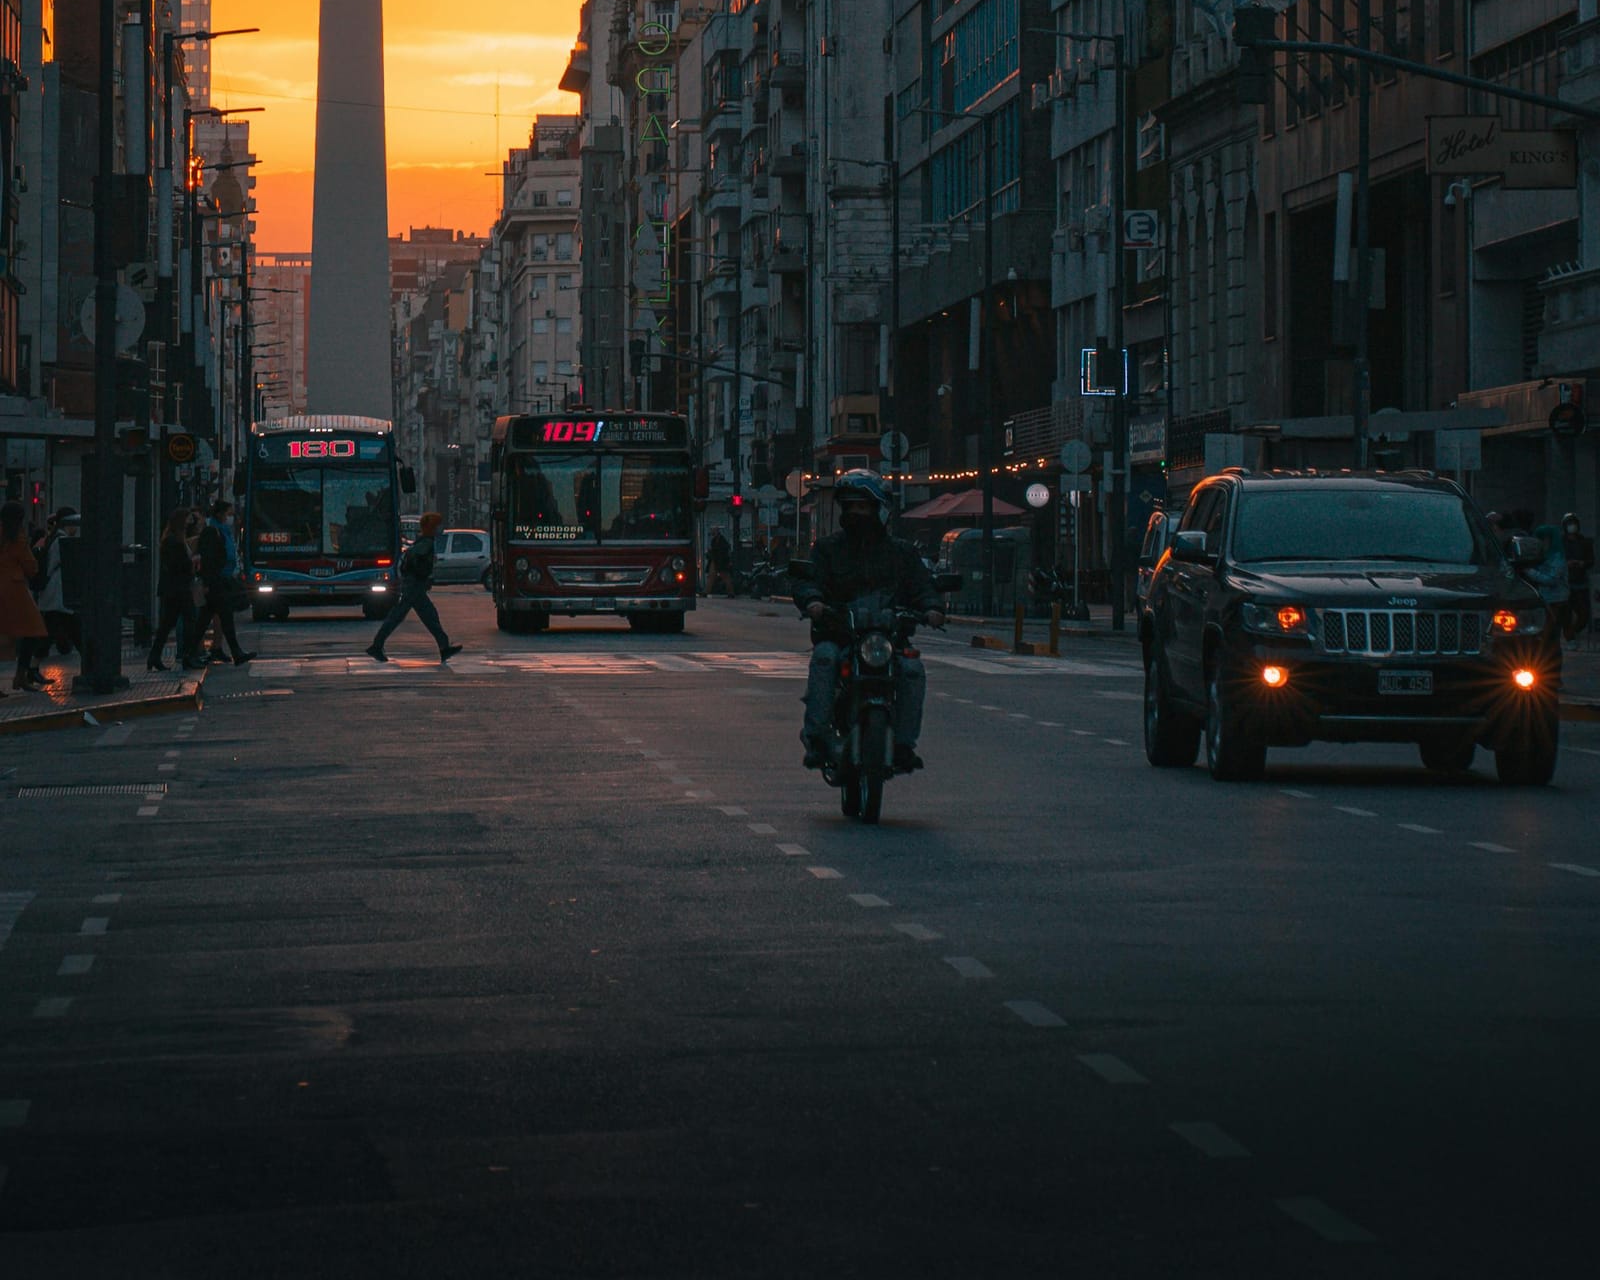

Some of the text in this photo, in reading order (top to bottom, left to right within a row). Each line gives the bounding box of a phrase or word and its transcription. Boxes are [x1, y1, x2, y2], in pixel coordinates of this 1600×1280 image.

[1436, 121, 1496, 165] Hotel
[1509, 150, 1569, 165] KING'S
[1130, 215, 1150, 240] E
[288, 440, 356, 458] 180
[536, 525, 584, 533] CORDOBA
[1388, 597, 1418, 607] Jeep
